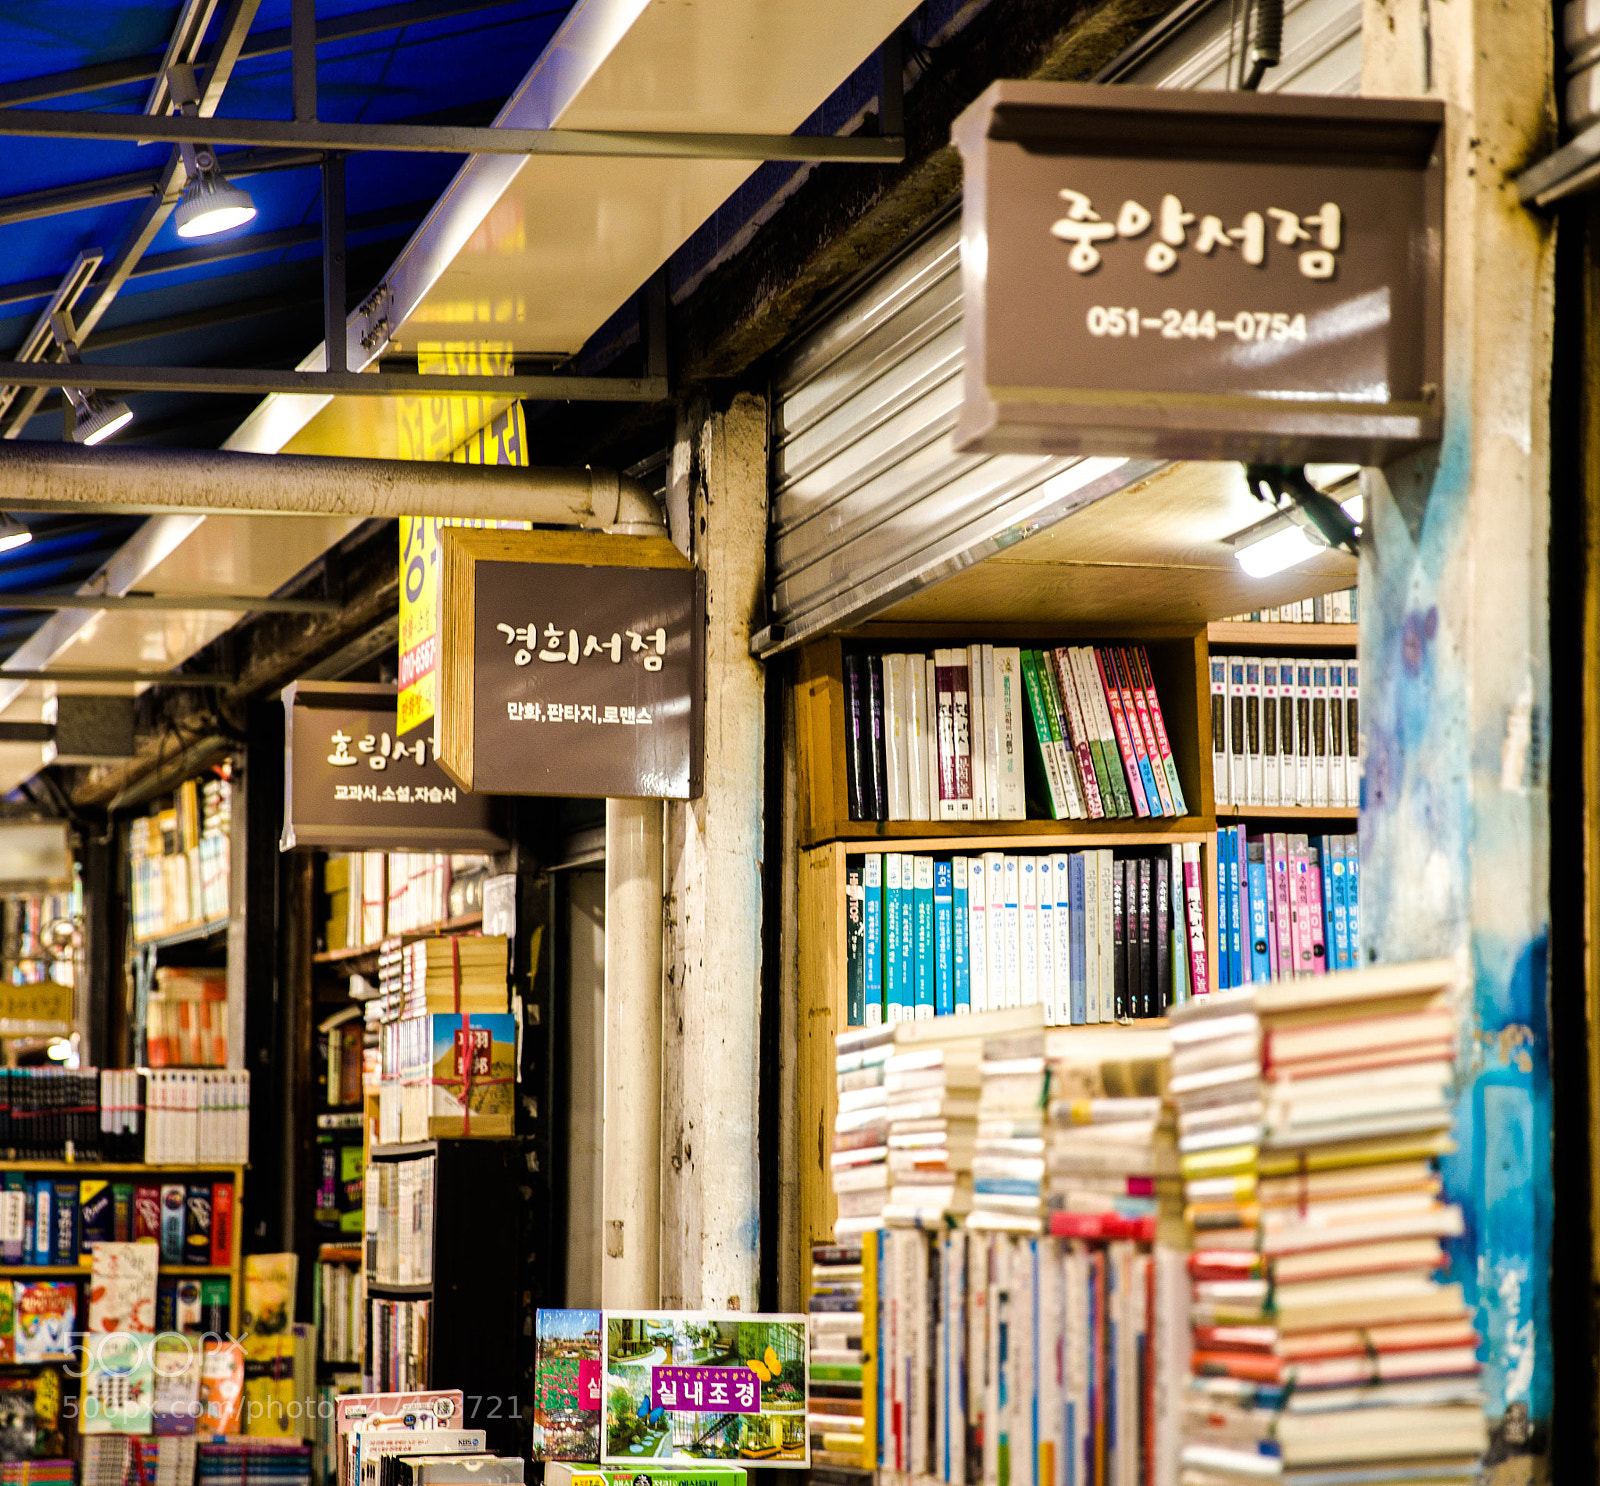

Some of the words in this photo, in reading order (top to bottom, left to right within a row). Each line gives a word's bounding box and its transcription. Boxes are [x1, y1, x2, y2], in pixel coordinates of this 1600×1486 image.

[1051, 188, 1341, 279] 중앙서점
[1087, 306, 1307, 341] 051-244-0754
[497, 622, 666, 671] 경희서점
[507, 702, 653, 725] 만화,판타지,로맨스
[334, 784, 457, 804] 교과서,소설,자습서
[657, 1380, 755, 1408] 실내조경
